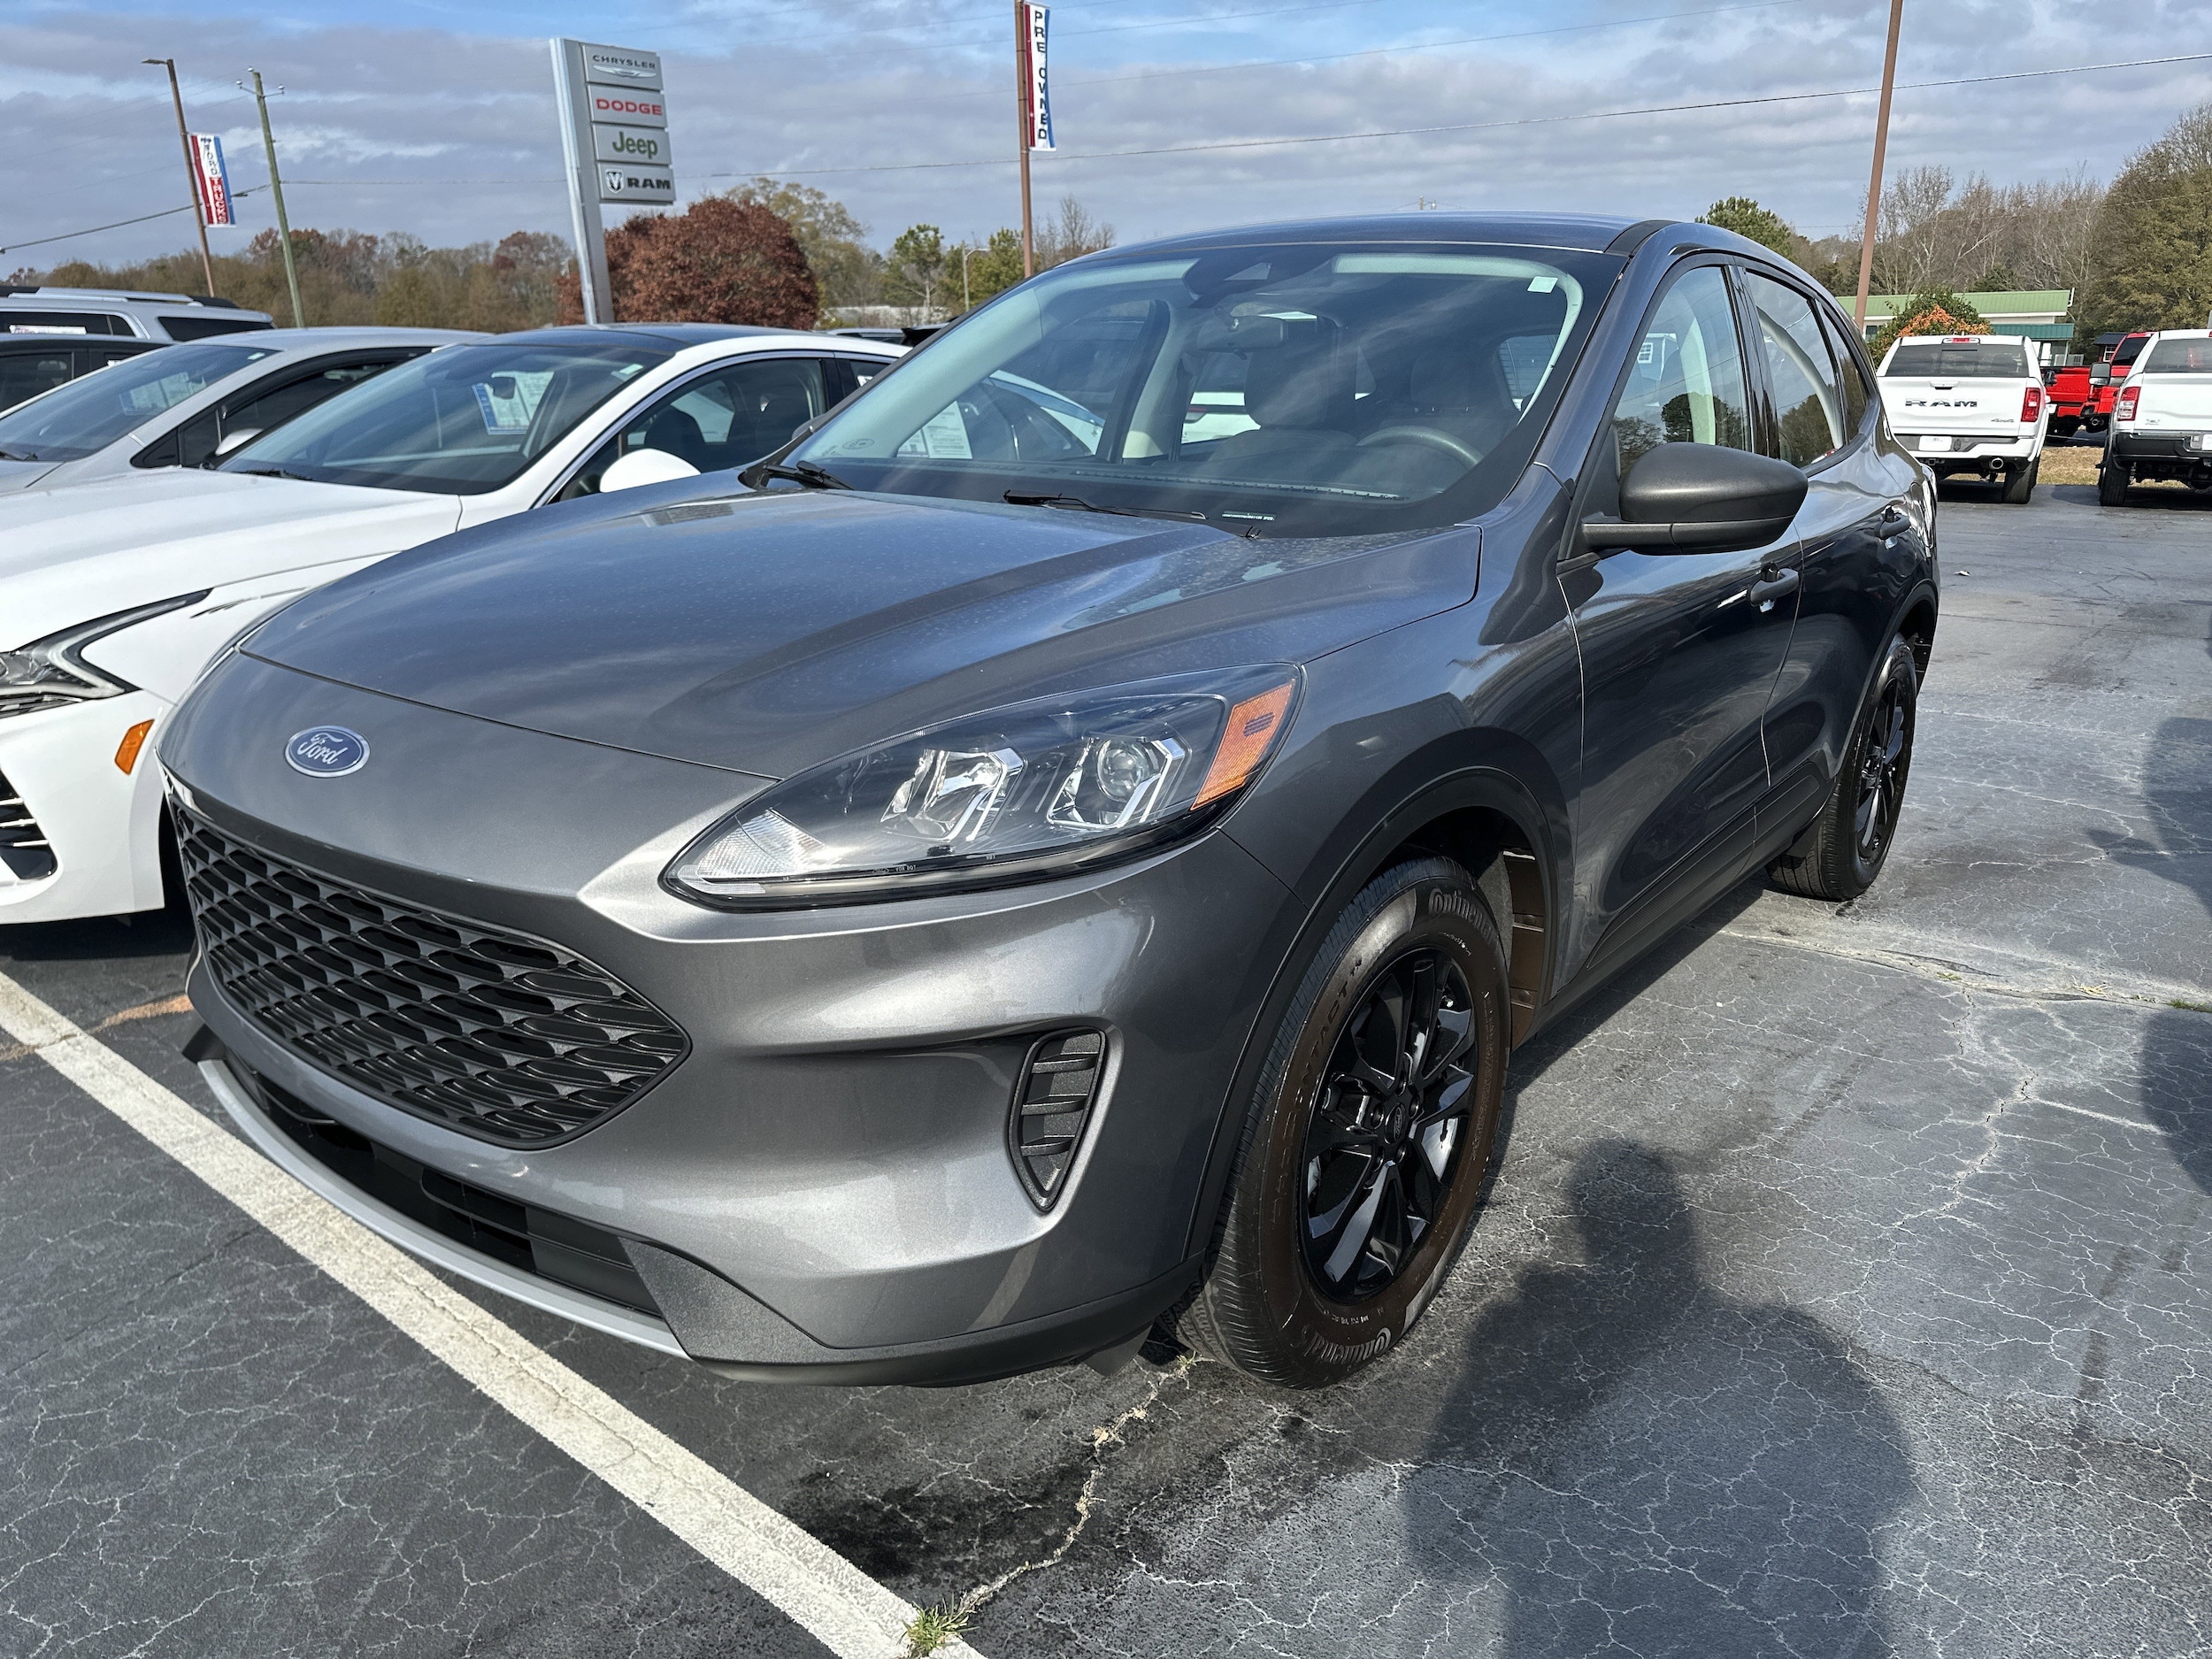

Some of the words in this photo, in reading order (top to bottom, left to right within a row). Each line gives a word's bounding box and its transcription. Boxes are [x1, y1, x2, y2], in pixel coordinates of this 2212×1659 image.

[1034, 10, 1046, 53] PRE
[592, 54, 656, 69] CHRYSLER
[595, 98, 663, 116] DODGE
[612, 131, 658, 159] Jeep
[627, 177, 672, 190] RAM
[212, 178, 227, 224] TRUCKS
[1905, 398, 1978, 407] RAM
[297, 733, 349, 764] Ford
